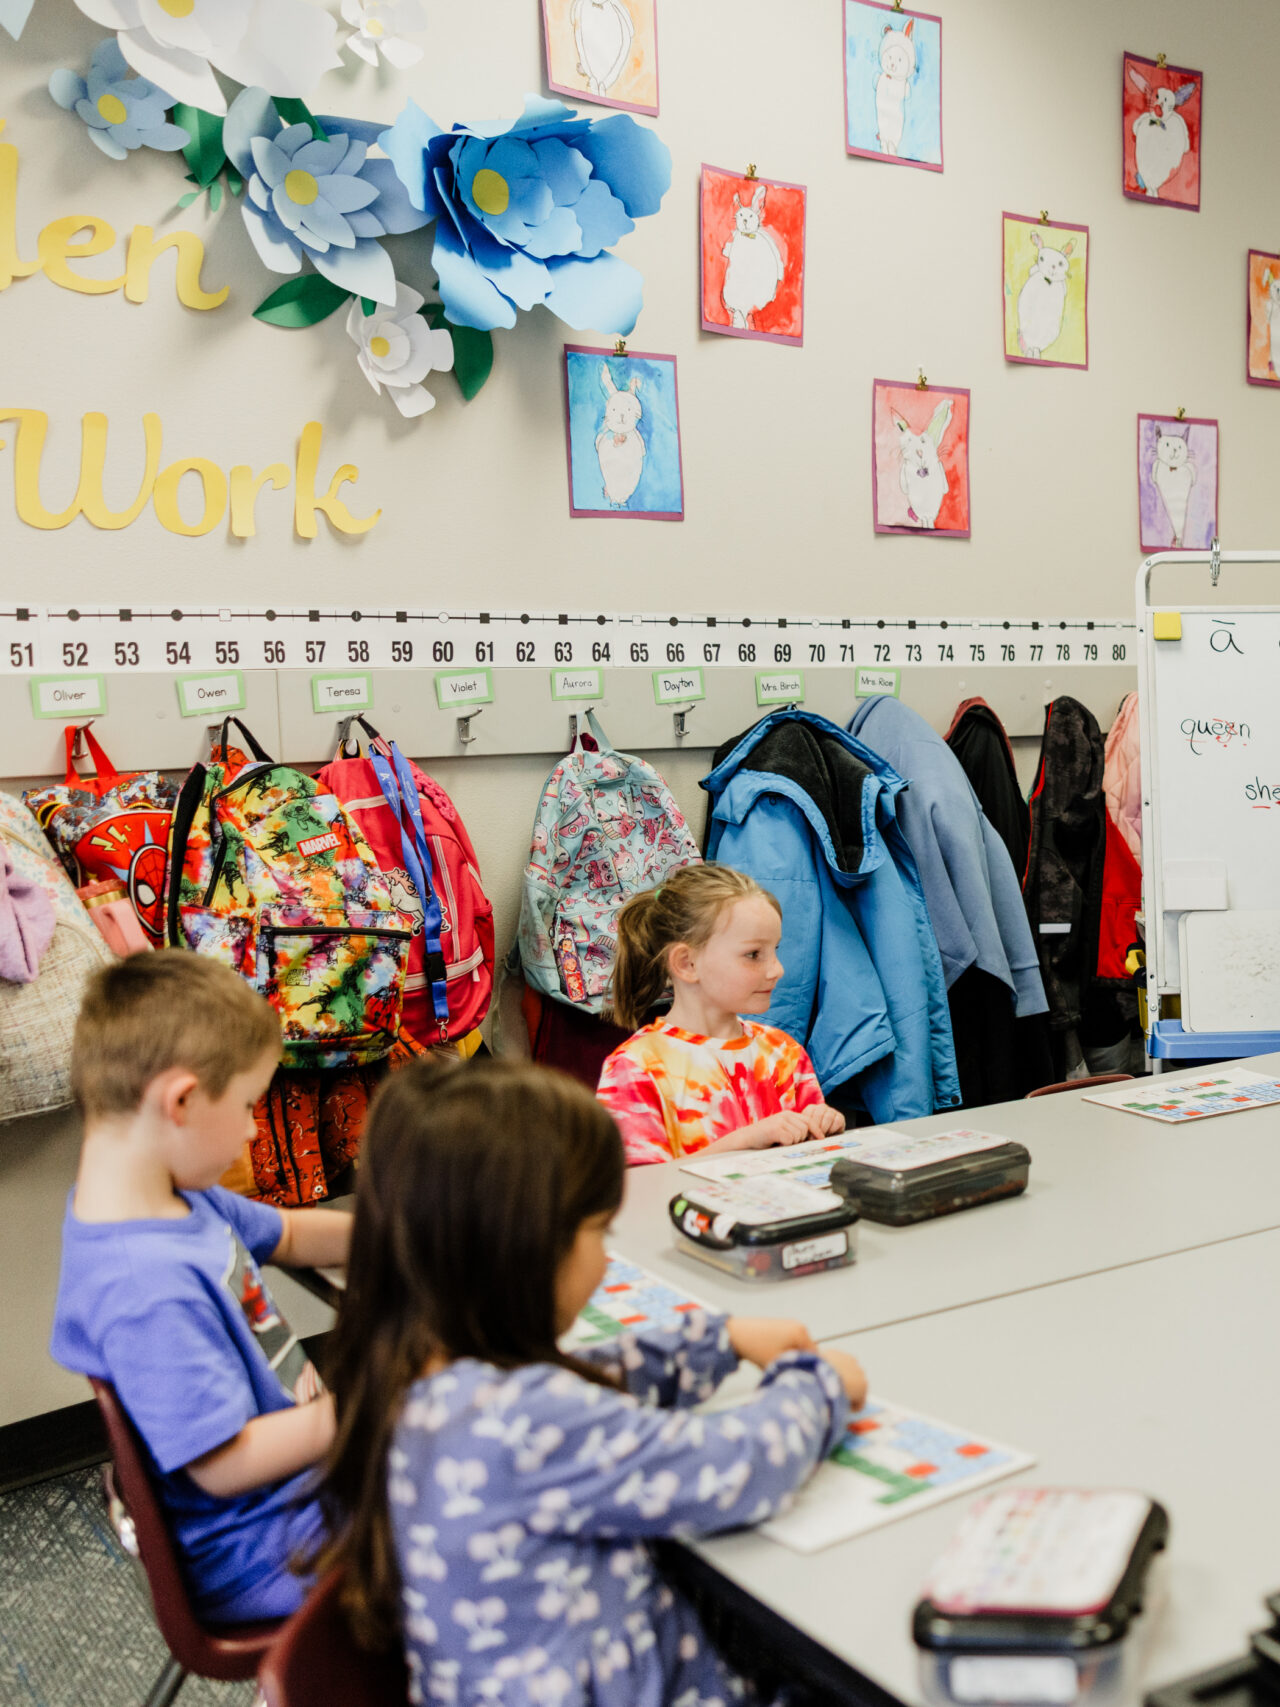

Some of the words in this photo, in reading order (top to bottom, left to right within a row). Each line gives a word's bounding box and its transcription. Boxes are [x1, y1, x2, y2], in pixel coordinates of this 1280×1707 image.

[0, 408, 382, 539] Work
[11, 643, 33, 667] 51
[63, 643, 88, 666] 52
[115, 642, 139, 665] 53
[167, 642, 191, 665] 54
[216, 641, 239, 664] 55
[264, 641, 285, 663] 56
[306, 641, 325, 663] 57
[348, 641, 369, 662] 58
[392, 641, 412, 662] 59
[433, 641, 453, 662] 60
[476, 641, 493, 662] 61
[516, 642, 535, 662] 62
[555, 642, 572, 662] 63
[592, 642, 610, 662] 64
[630, 643, 649, 662] 65
[667, 643, 684, 662] 66
[704, 644, 720, 662] 67
[739, 644, 756, 662] 68
[774, 644, 791, 662] 69
[809, 644, 825, 662] 70
[840, 645, 854, 662] 71
[874, 645, 890, 661] 72
[906, 645, 922, 661] 73
[938, 645, 954, 661] 74
[970, 645, 985, 661] 75
[1001, 645, 1015, 661] 76
[1030, 645, 1043, 661] 77
[1056, 644, 1070, 660] 78
[1084, 644, 1097, 660] 79
[1112, 644, 1125, 660] 80
[451, 681, 476, 692] Violet
[563, 678, 592, 688] Aurora
[664, 678, 693, 692] Dayton
[762, 683, 779, 691] Mrs.
[780, 682, 799, 690] Birch
[862, 677, 877, 685] Mrs.
[879, 678, 893, 686] Rice
[53, 690, 86, 701] Oliver
[198, 688, 226, 698] Owen
[327, 687, 360, 696] Teresa
[300, 833, 341, 855] MARVEL
